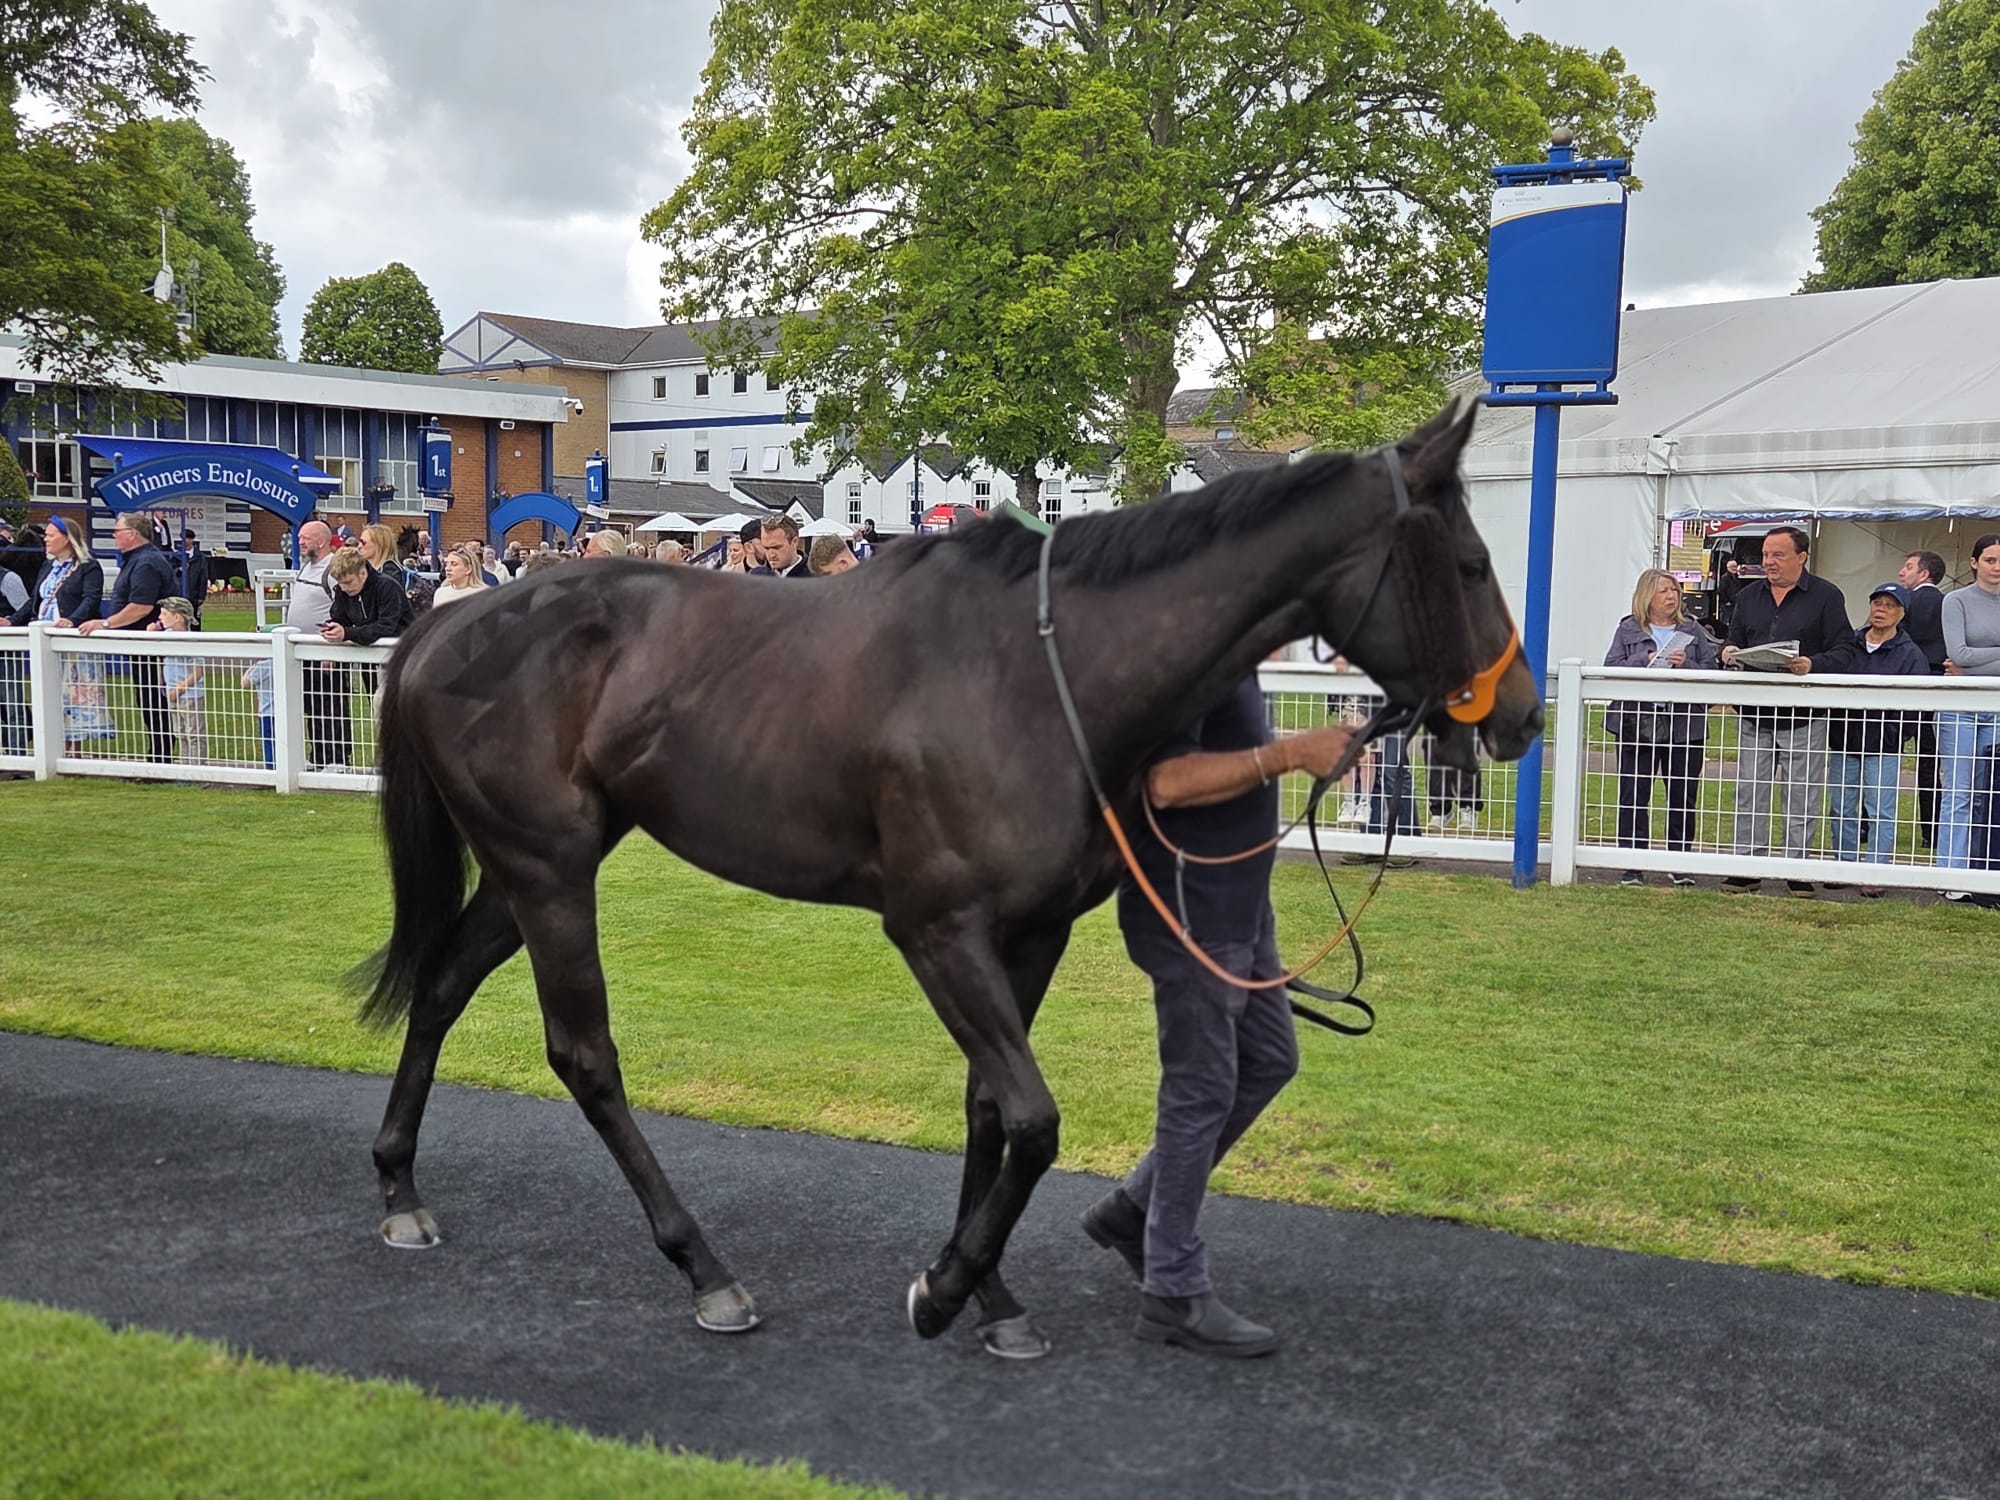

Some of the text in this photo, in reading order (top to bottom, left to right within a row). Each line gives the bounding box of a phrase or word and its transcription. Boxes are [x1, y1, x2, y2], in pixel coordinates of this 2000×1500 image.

[431, 454, 446, 477] 1st
[116, 462, 299, 508] Winners Enclosure
